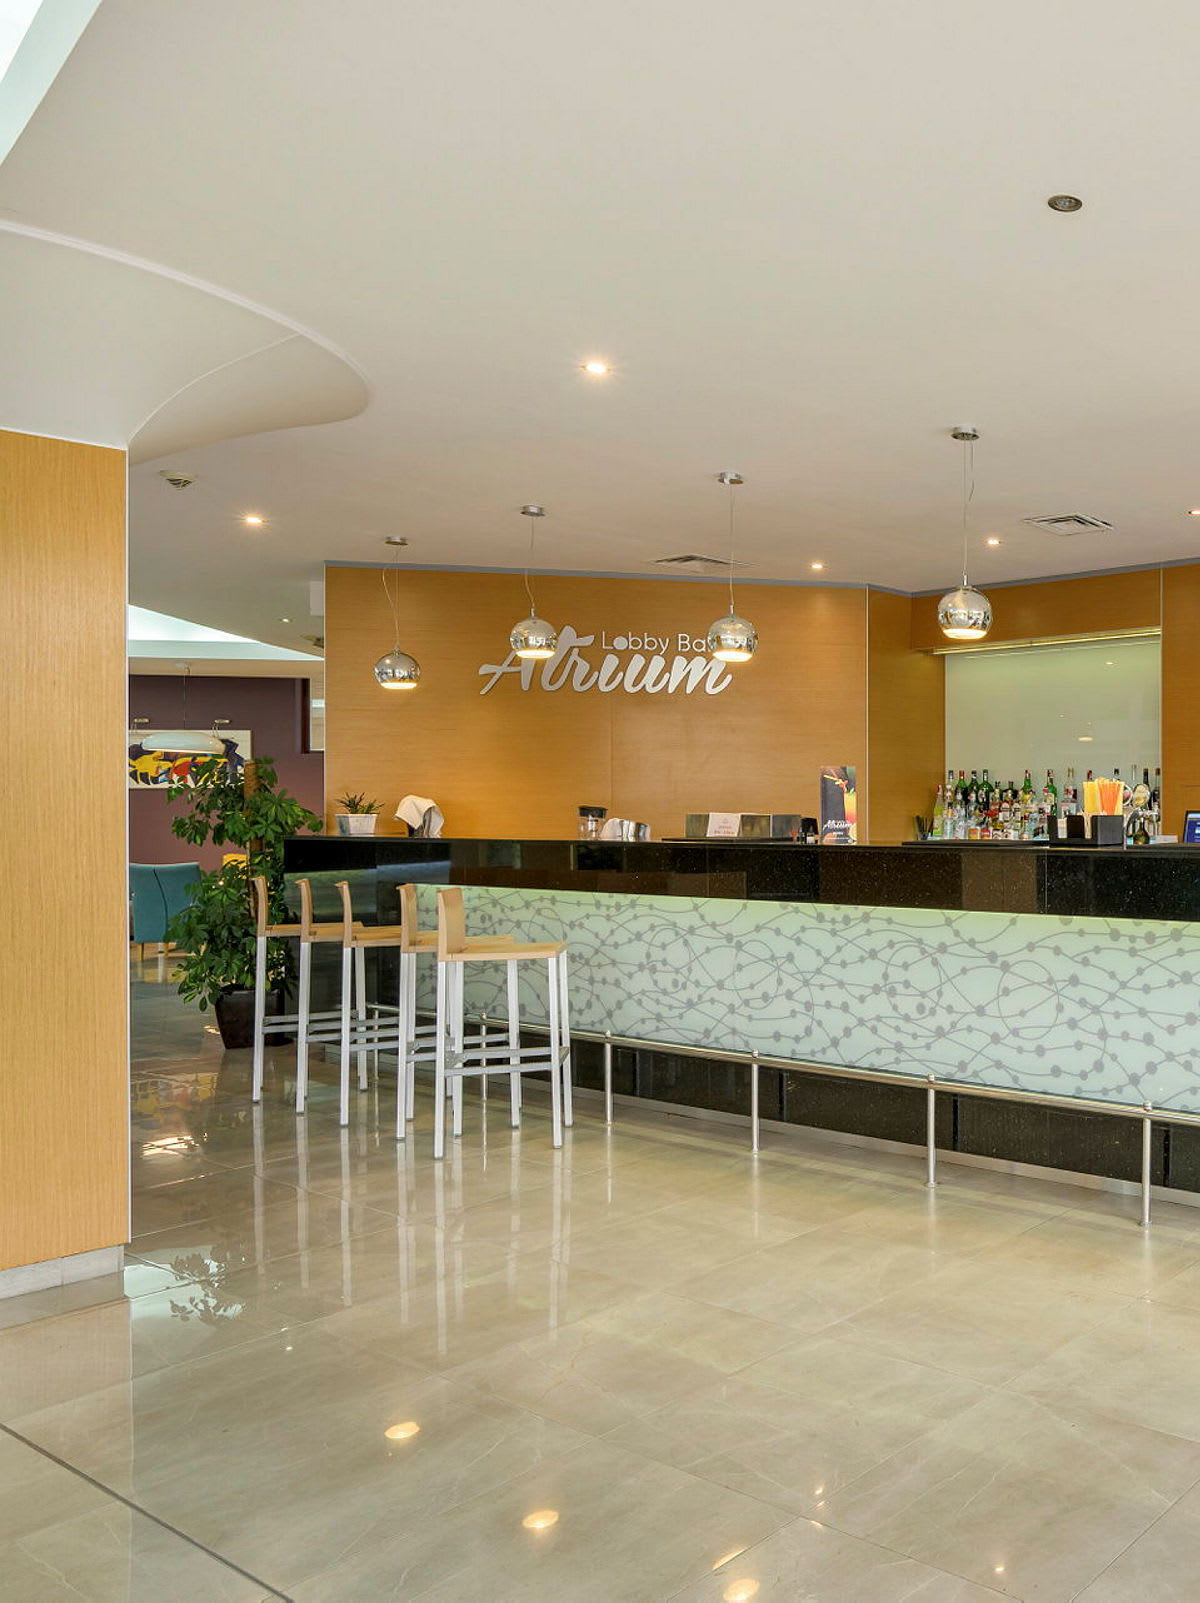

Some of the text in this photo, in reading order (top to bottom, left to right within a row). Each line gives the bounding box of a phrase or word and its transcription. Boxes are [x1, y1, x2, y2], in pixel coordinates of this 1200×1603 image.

[478, 625, 733, 695] Atrium
[602, 631, 712, 655] Lobby Ba
